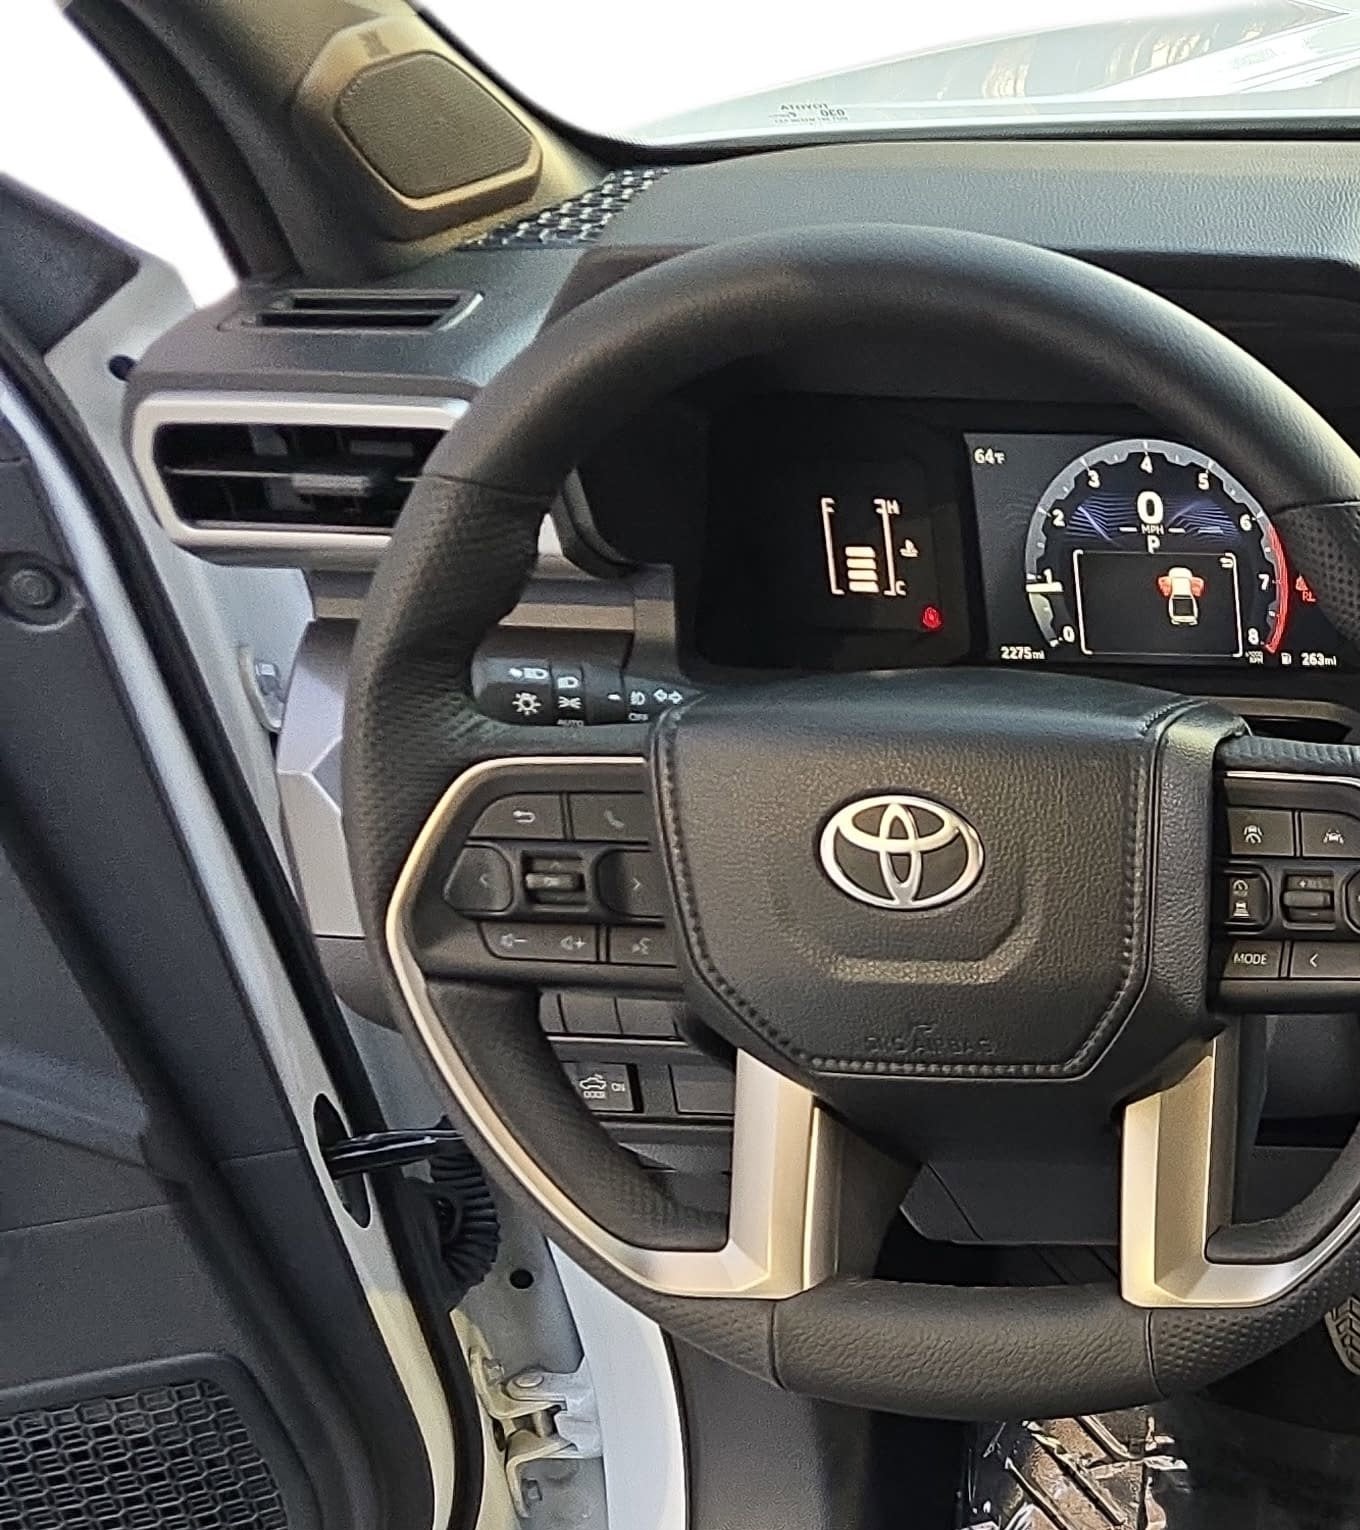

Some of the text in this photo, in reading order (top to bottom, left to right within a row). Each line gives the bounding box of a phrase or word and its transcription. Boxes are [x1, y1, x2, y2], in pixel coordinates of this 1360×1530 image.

[1141, 456, 1153, 474] 4
[1088, 470, 1101, 489] 3
[1198, 472, 1210, 491] 5
[1136, 490, 1164, 525] 0
[1053, 508, 1066, 528] 2
[1240, 513, 1253, 532] 6
[1142, 524, 1165, 536] MPH
[1147, 536, 1161, 555] P
[1258, 573, 1270, 591] 7
[1063, 625, 1075, 643] 0
[1248, 627, 1259, 645] 8
[1233, 952, 1268, 966] MODE
